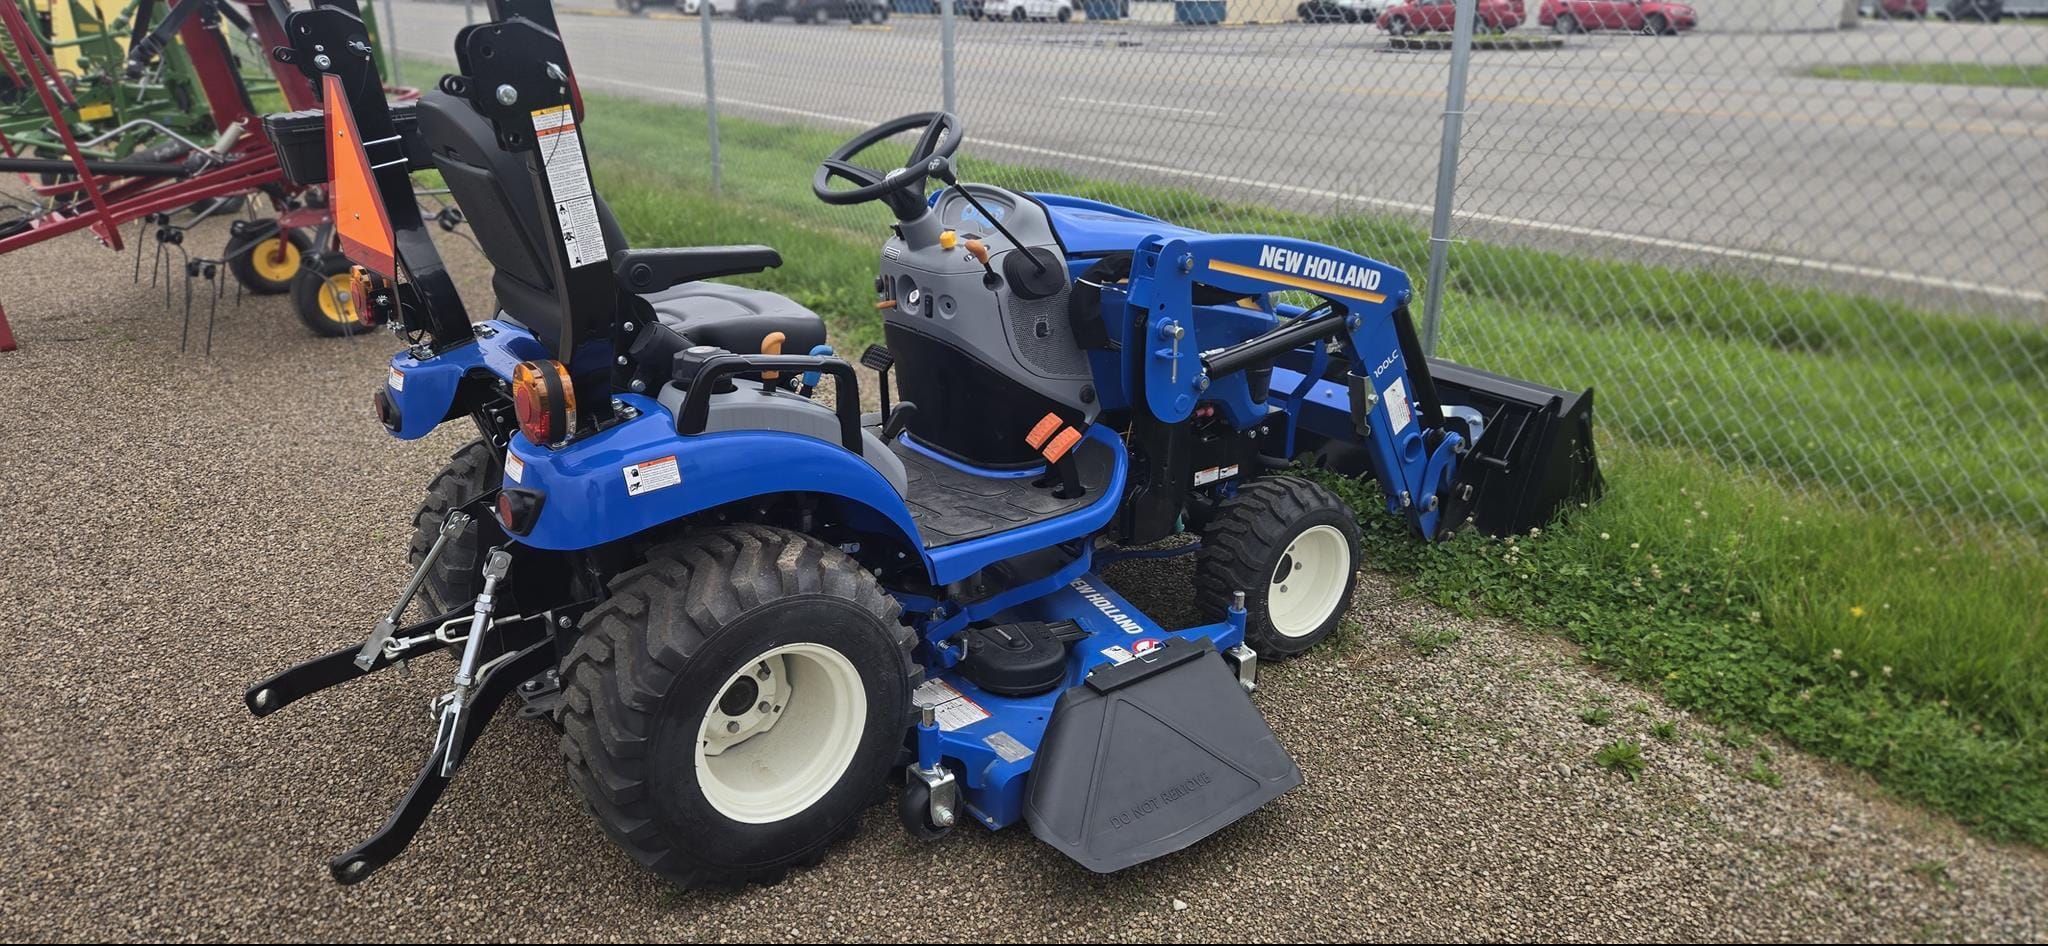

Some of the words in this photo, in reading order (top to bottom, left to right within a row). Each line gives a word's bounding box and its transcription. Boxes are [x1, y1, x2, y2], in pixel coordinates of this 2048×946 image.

[1259, 244, 1304, 274] NEW
[1303, 254, 1381, 291] HOLLAND
[1373, 349, 1400, 378] 100LC
[1070, 578, 1097, 594] EW
[1085, 593, 1144, 635] HOLLAND
[1109, 810, 1131, 830] DO
[1131, 795, 1160, 819] NOT
[1160, 770, 1212, 806] REMOVE
